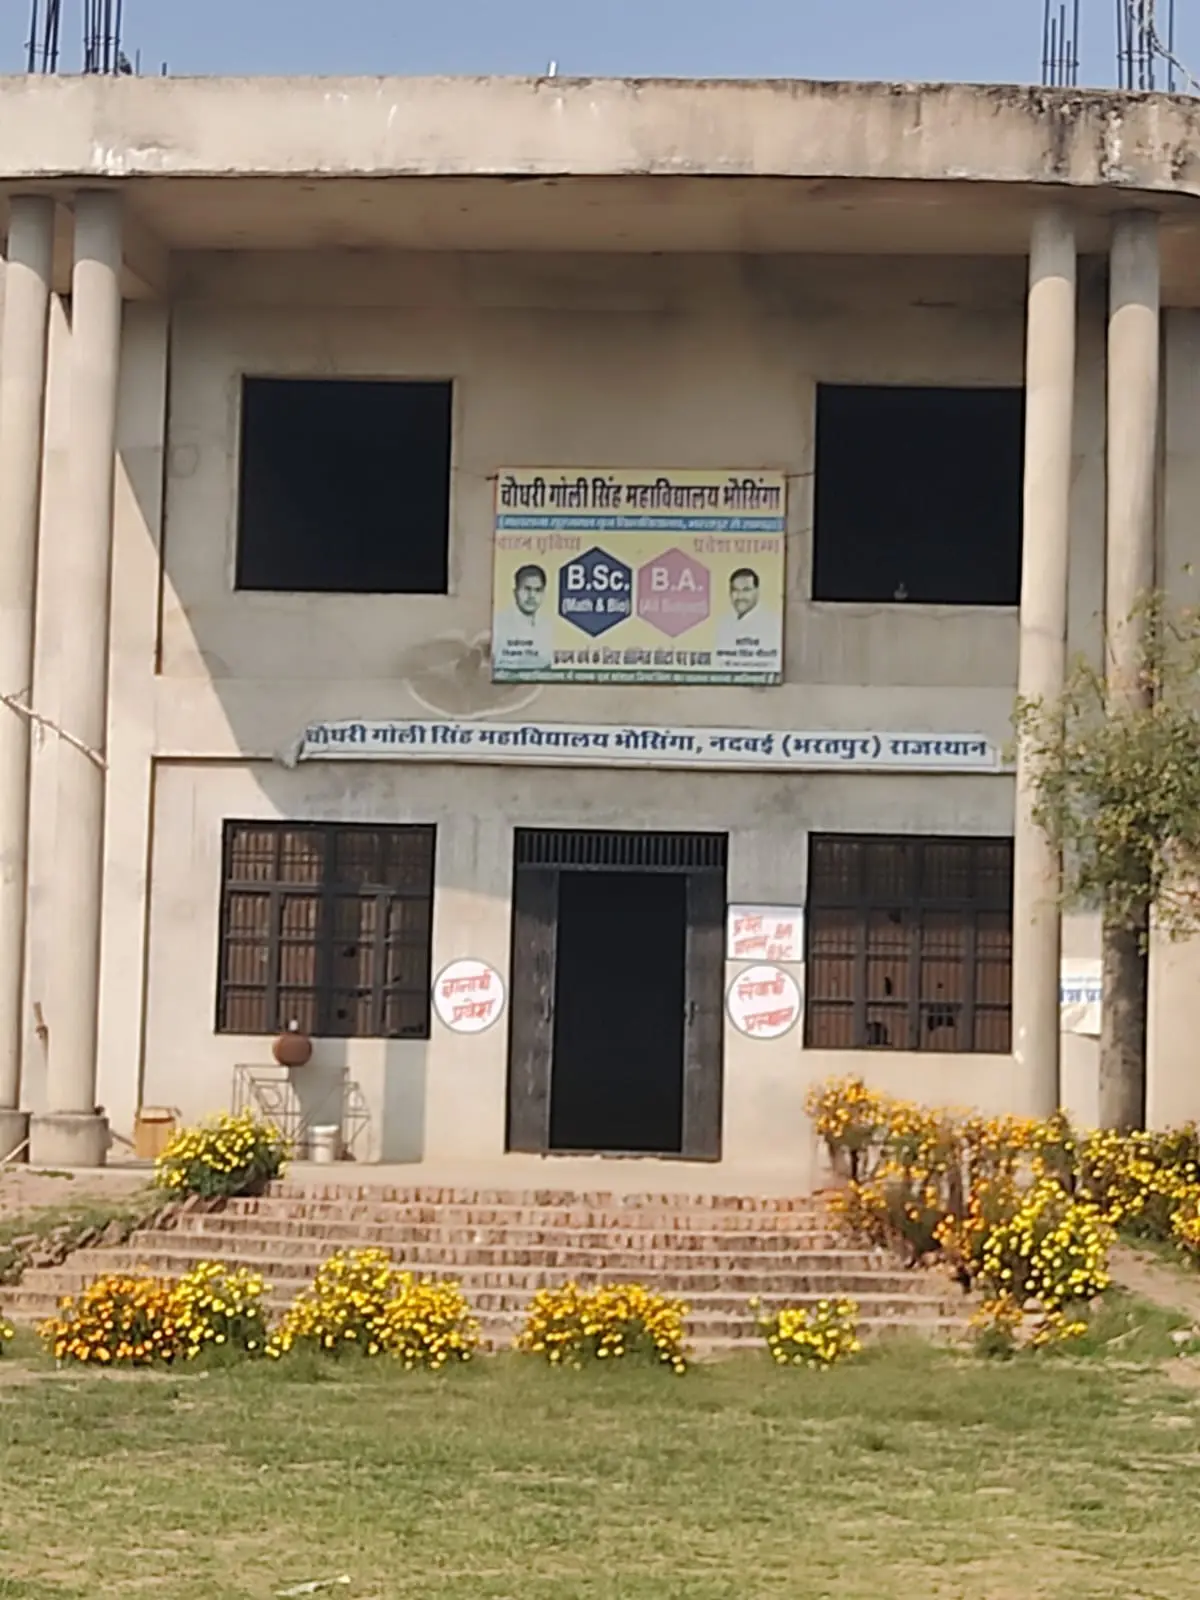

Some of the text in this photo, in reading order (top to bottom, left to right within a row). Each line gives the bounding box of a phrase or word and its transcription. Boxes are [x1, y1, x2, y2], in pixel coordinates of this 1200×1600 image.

[592, 477, 621, 509] सिंह
[626, 478, 720, 510] महाविद्यालय
[567, 564, 630, 591] B.Sc.
[651, 567, 704, 592] B.A.
[371, 724, 426, 744] गोली
[431, 724, 472, 745] सिंह
[478, 727, 610, 749] महाविद्यालय
[781, 734, 882, 760] (भरतपुर)
[889, 739, 986, 757] राजस्थान
